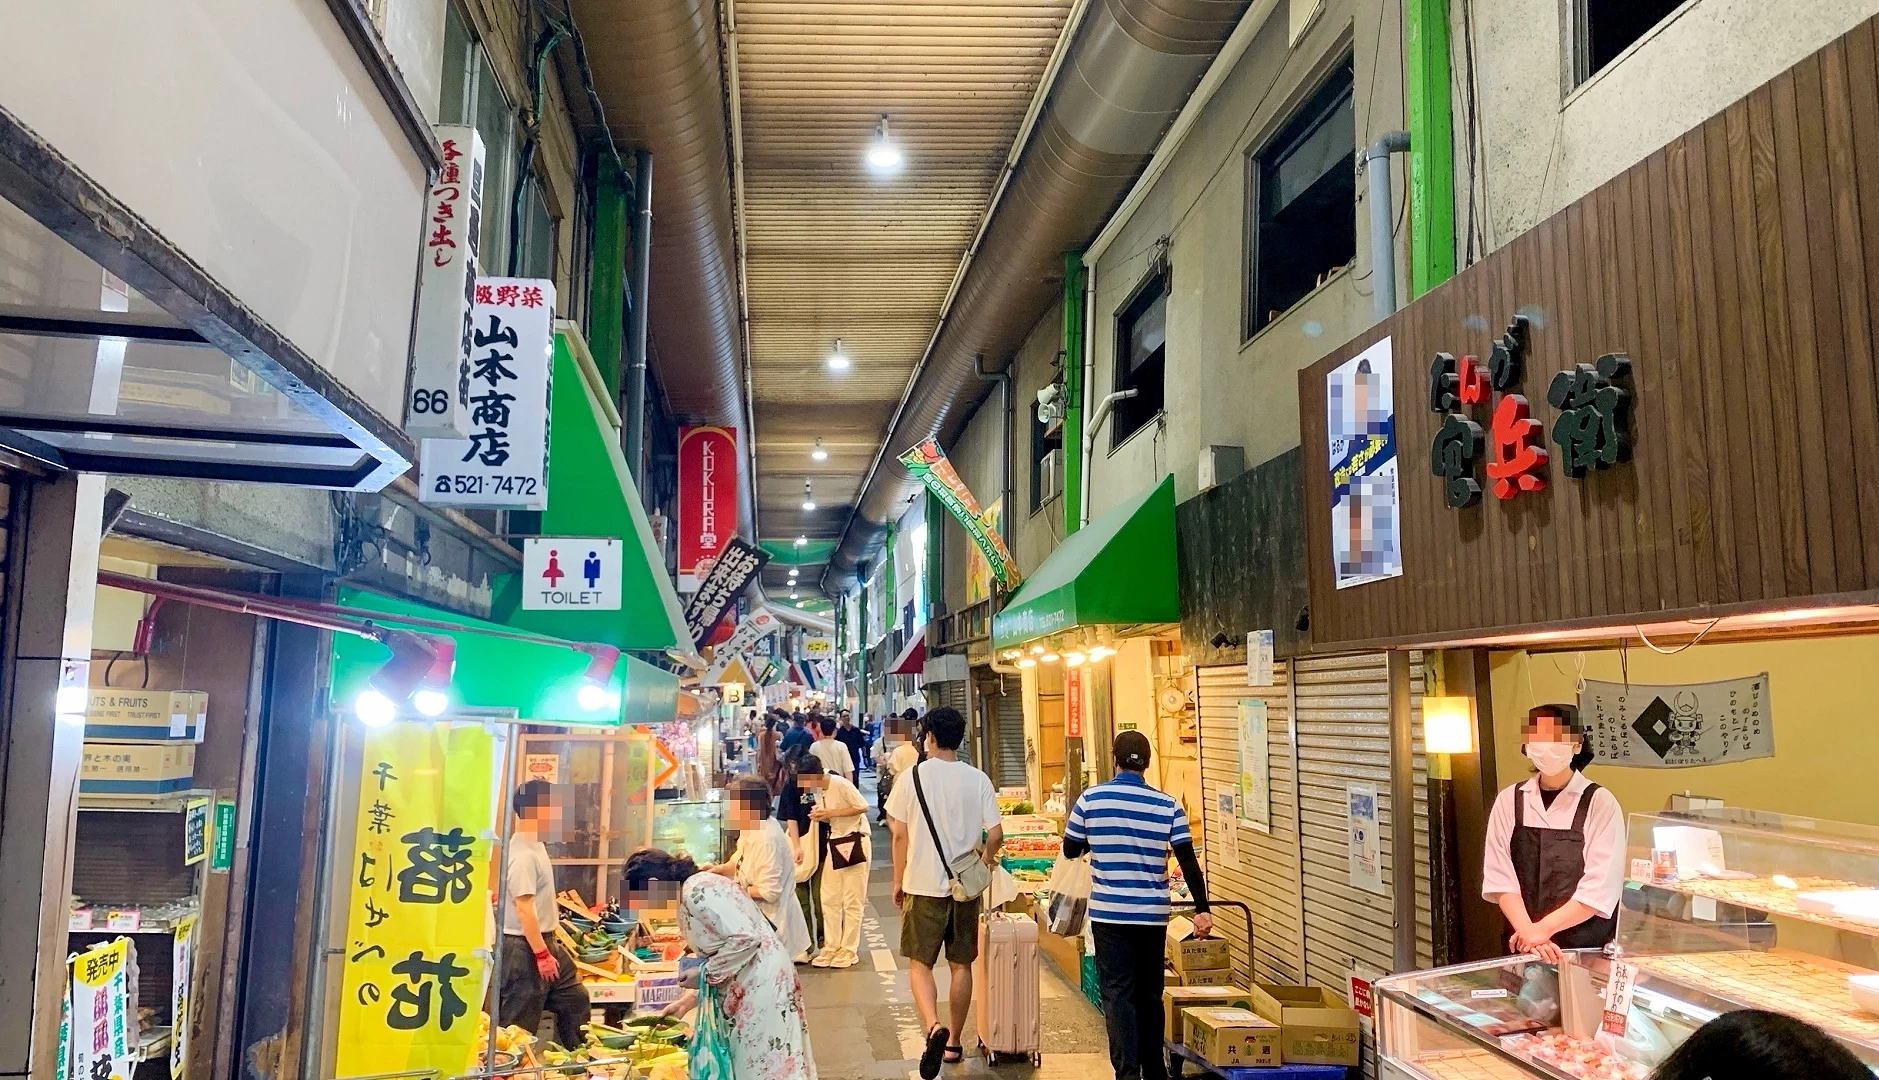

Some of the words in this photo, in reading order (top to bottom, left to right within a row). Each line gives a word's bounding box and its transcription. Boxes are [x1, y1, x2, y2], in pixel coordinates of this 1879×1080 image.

[413, 388, 449, 414] 66
[461, 314, 519, 467] 山本商店
[541, 591, 603, 605] TOILET
[691, 553, 759, 640] お持ち帰り
[118, 698, 149, 709] FRUITS
[86, 949, 120, 984] 発売中
